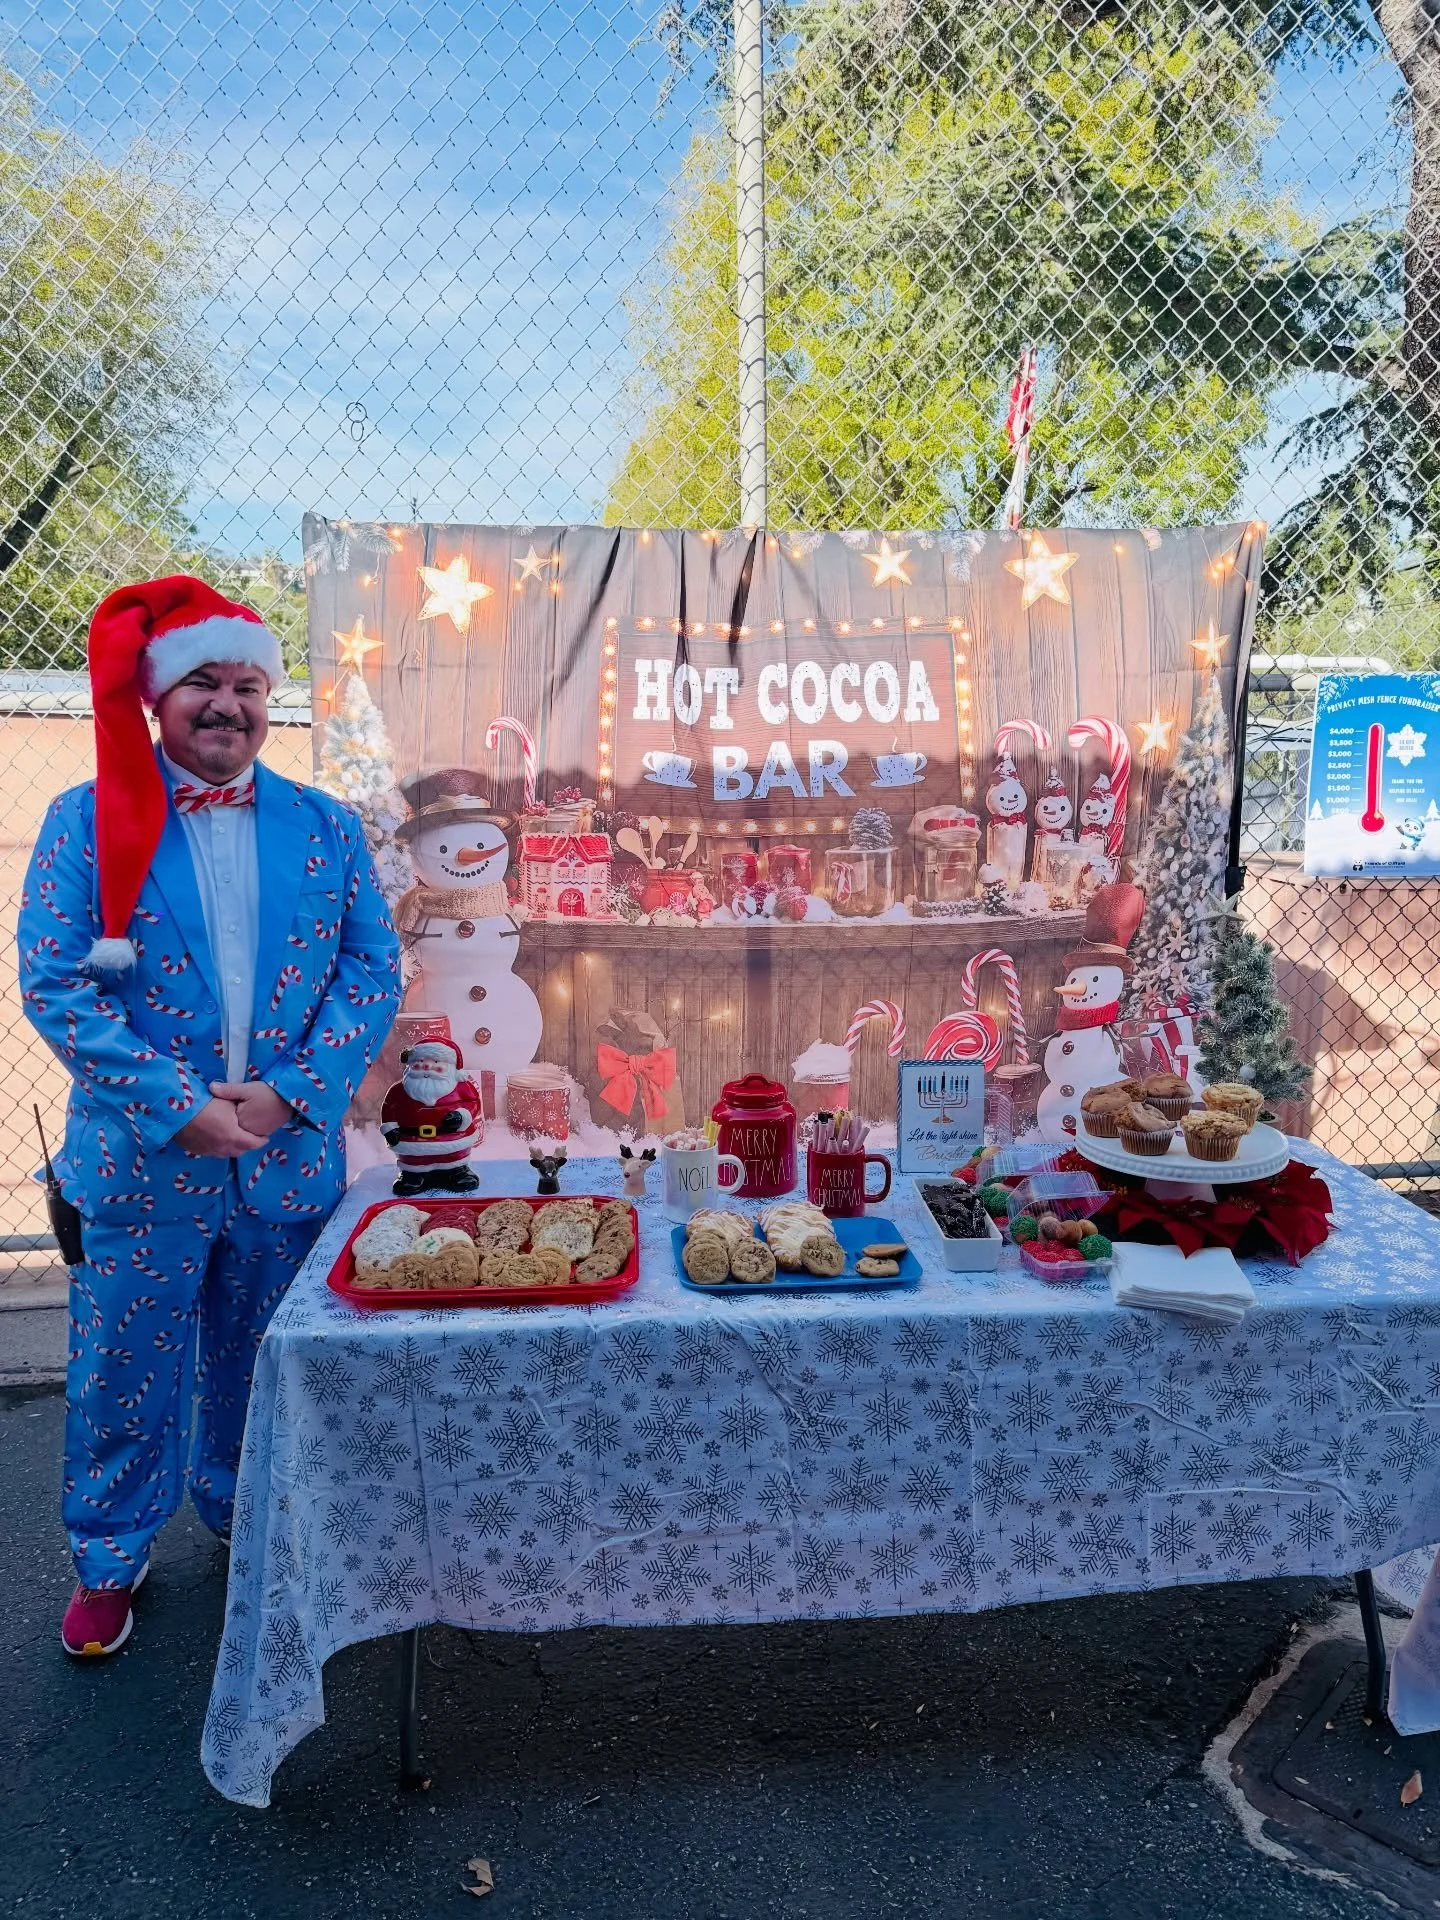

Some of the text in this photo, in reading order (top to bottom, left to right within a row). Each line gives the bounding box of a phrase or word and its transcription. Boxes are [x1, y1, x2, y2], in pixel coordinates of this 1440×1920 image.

[633, 659, 940, 730] HOT COCOA
[1327, 698, 1356, 714] PRIVACY
[1358, 696, 1375, 706] MESH
[1377, 695, 1397, 704] FENCE
[1329, 727, 1354, 735] $4,000
[1329, 739, 1353, 747] $3,500
[1328, 750, 1352, 758] $3,000
[713, 739, 856, 801] BAR
[1327, 773, 1351, 781] $2,000
[1326, 796, 1350, 804] $1,000
[729, 1127, 778, 1156] MERRY
[907, 1127, 978, 1144] Let the ight shine
[820, 1168, 855, 1188] MERRY
[813, 1187, 861, 1208] CHRISTMAS
